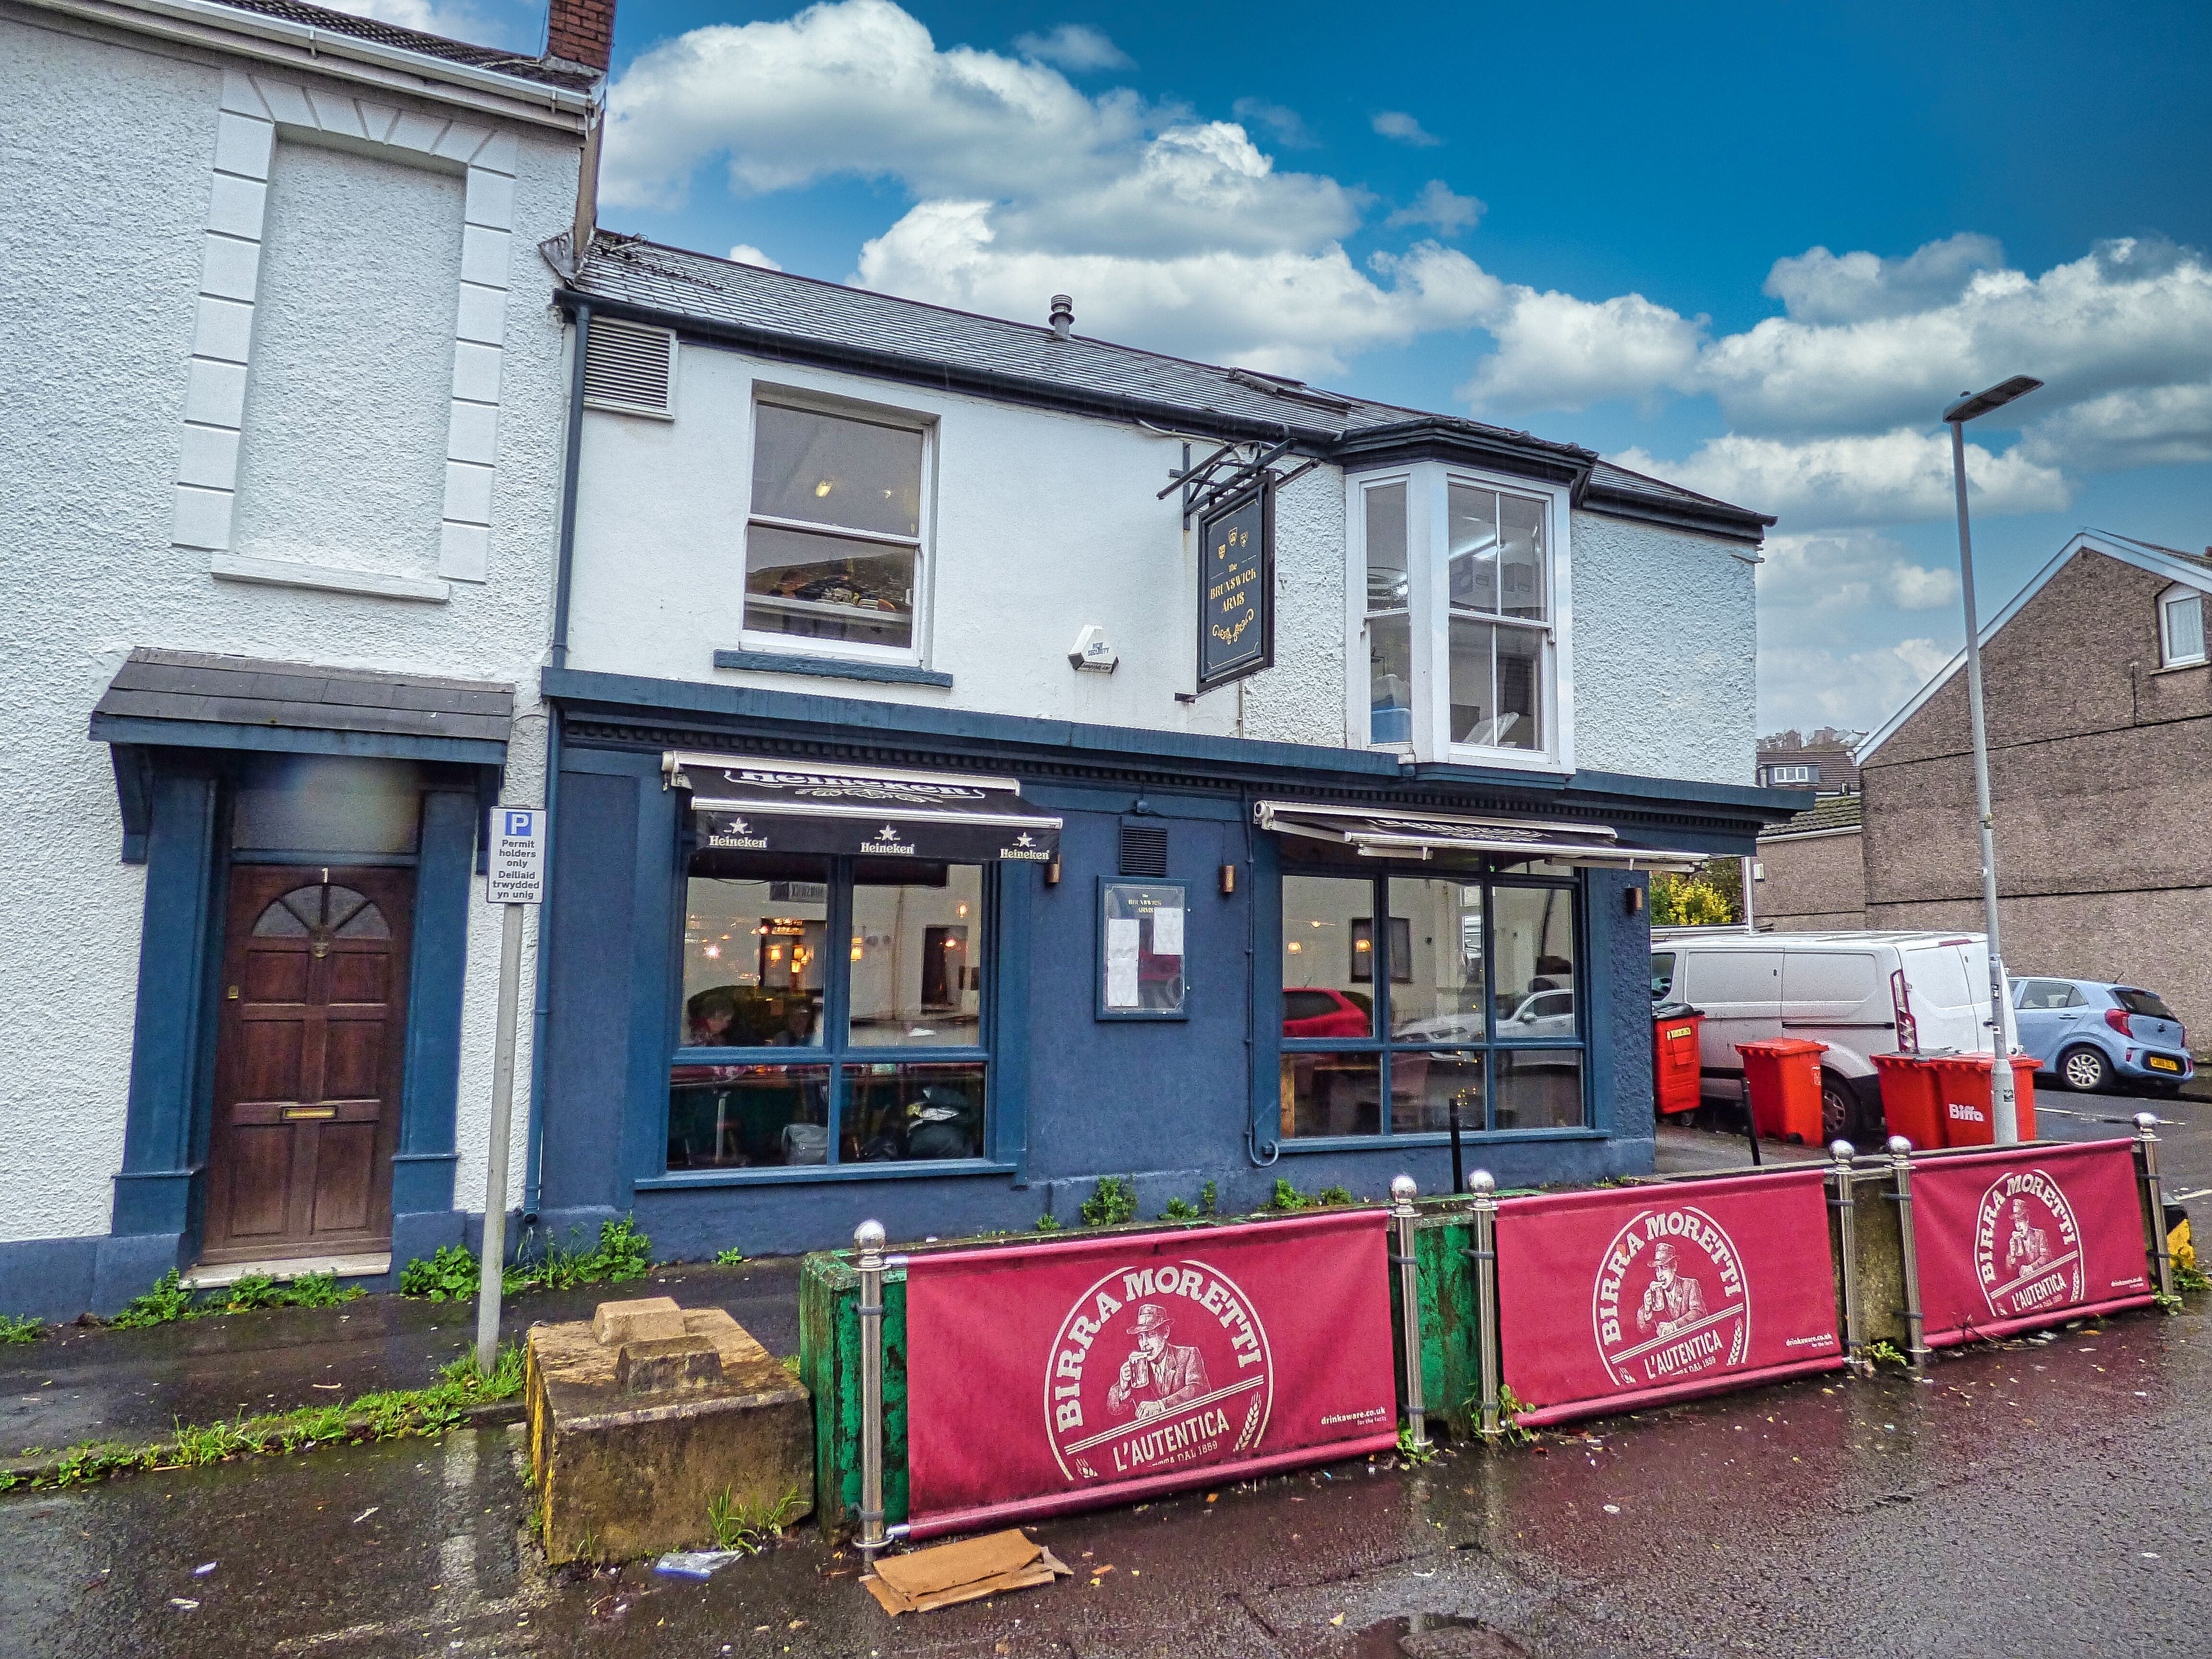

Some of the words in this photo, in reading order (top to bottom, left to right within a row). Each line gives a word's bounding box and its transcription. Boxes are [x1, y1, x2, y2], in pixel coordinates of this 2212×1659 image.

[1210, 568, 1256, 600] BRUNSWICK
[1222, 591, 1245, 613] ARMS
[511, 814, 529, 834] P
[502, 839, 534, 848] Permit
[709, 835, 767, 848] Heineken
[860, 842, 914, 854] Heineken
[499, 849, 536, 858] holders
[1000, 848, 1050, 860] Heineken
[506, 859, 528, 868] only
[322, 867, 328, 883] 1
[498, 870, 535, 879] Deiliaid
[493, 880, 540, 890] trwydded
[513, 891, 534, 900] unig
[1948, 1104, 1984, 1122] Biffa
[1980, 1190, 2006, 1283] BIRRA
[2007, 1173, 2076, 1245] MORETTI
[1599, 1232, 1645, 1346] BIRRA
[1645, 1211, 1743, 1298] MORETTI
[2011, 1272, 2067, 1311] L'AUTENTICA
[1055, 1291, 1123, 1433] BIRRA
[1122, 1266, 1262, 1369] MORETTI
[1644, 1329, 1724, 1380] L'AUTENTICA
[1321, 1407, 1386, 1425] drinkaware.co.uk
[1113, 1408, 1230, 1472] L'AUTENTICA
[1177, 1448, 1196, 1462] DAL
